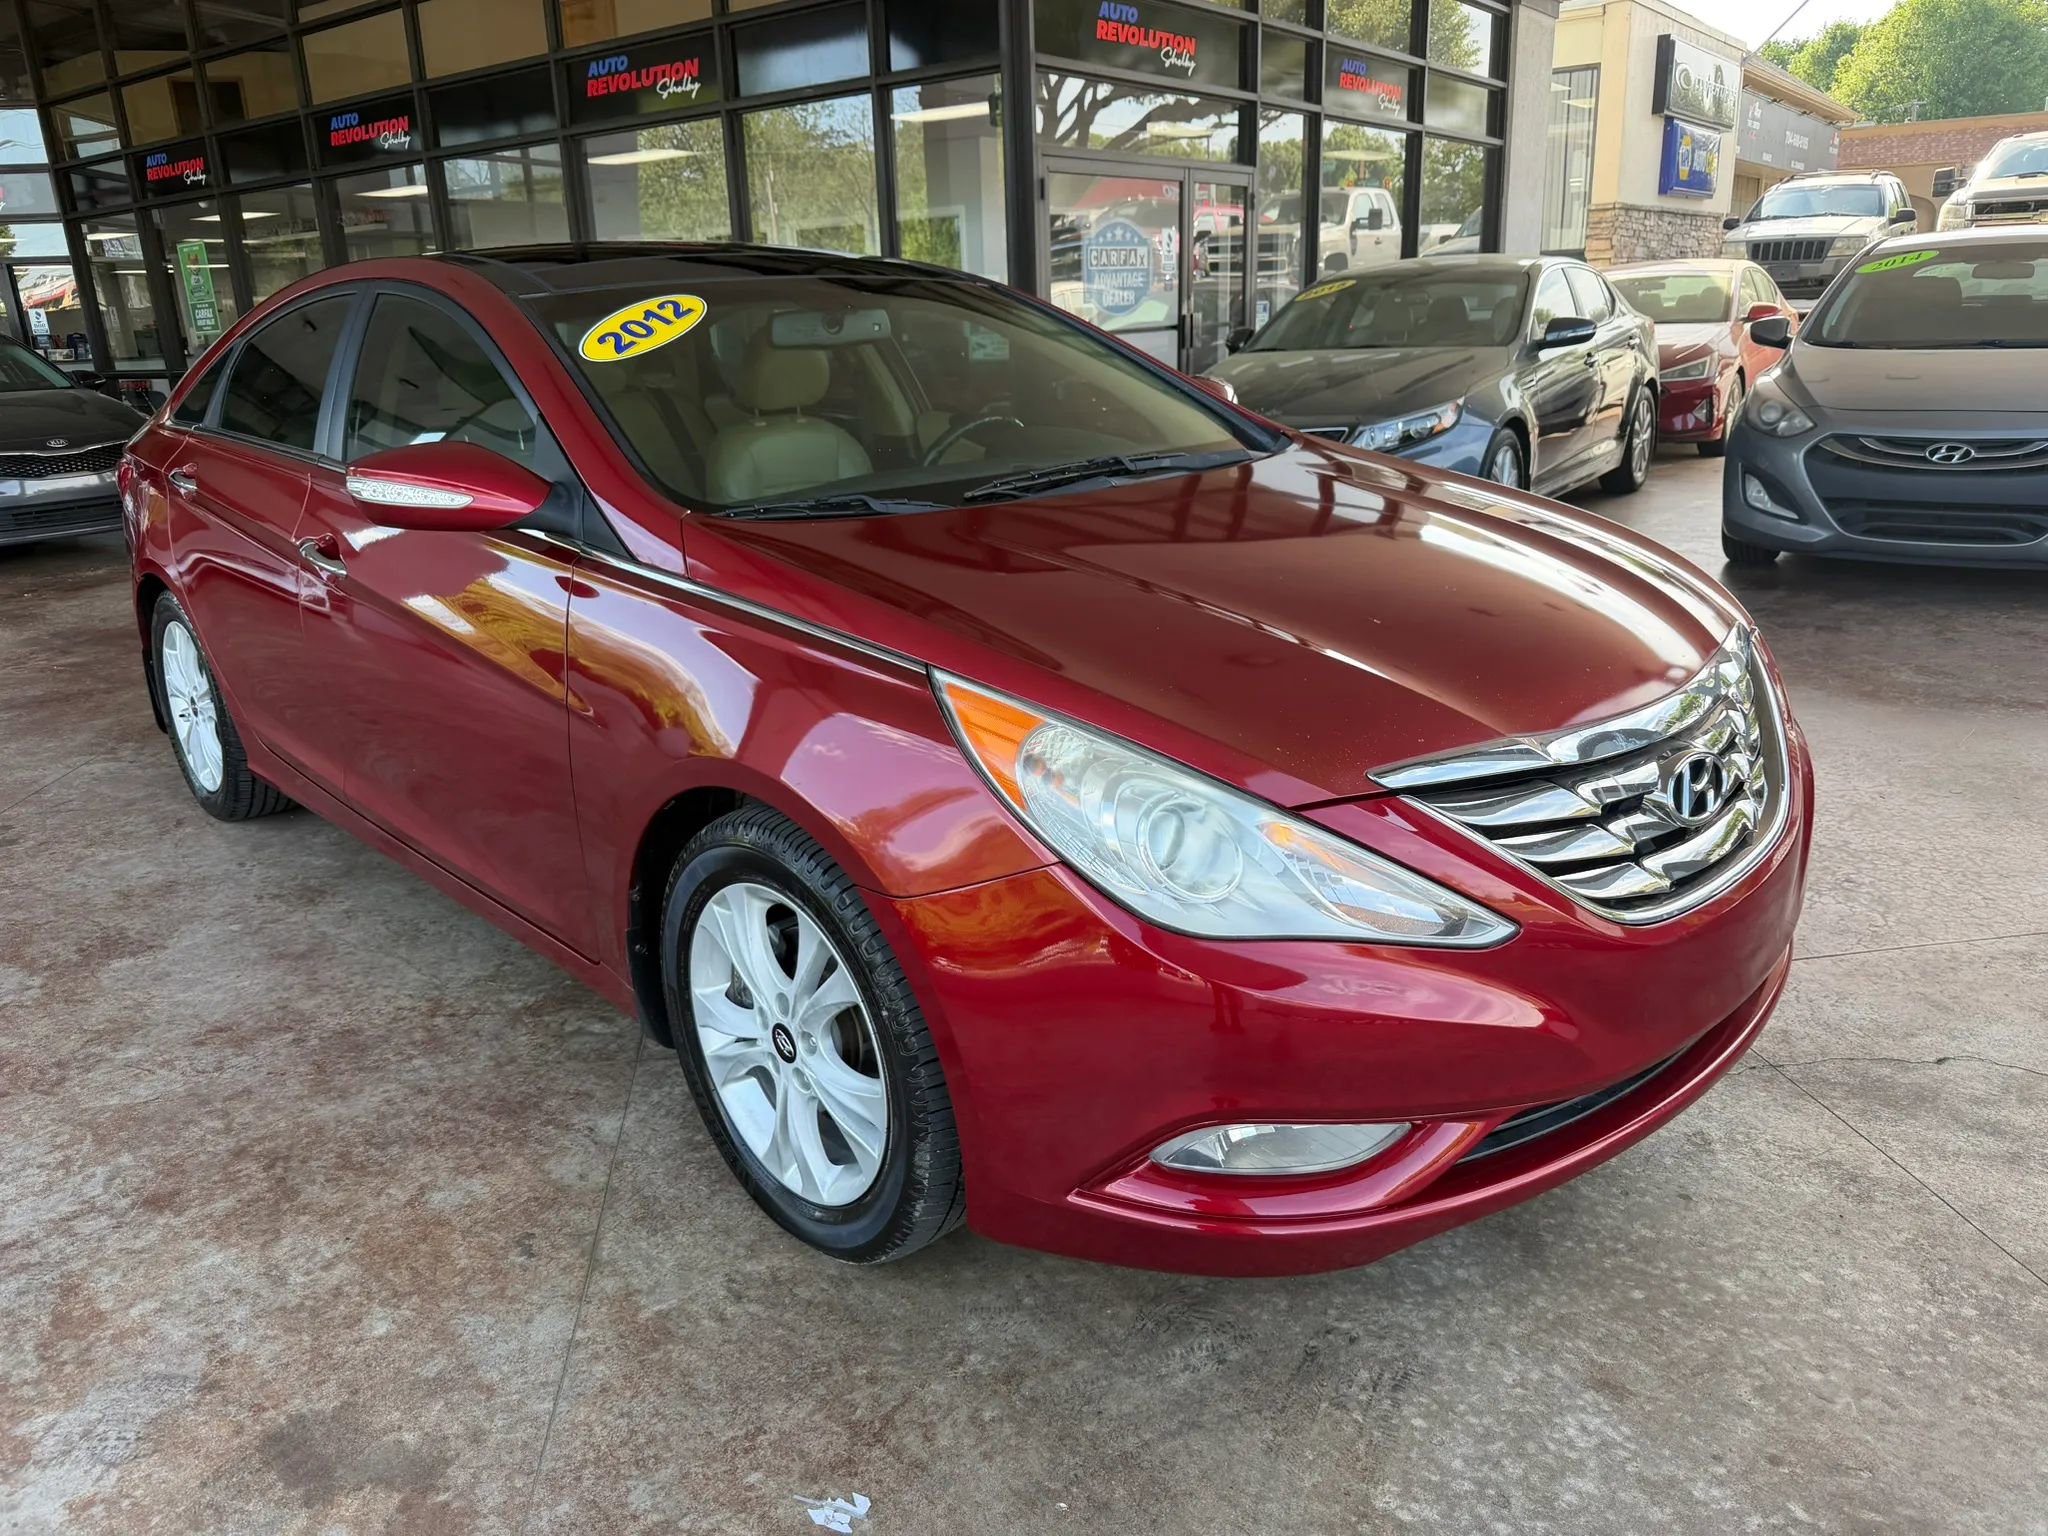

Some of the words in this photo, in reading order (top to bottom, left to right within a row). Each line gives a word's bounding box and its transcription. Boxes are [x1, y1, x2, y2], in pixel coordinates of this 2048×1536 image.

[1099, 1, 1138, 23] AUTO
[1096, 19, 1196, 56] REVOLUTION
[588, 55, 628, 77] AUTO
[1160, 46, 1196, 77] Shelby
[1341, 58, 1367, 75] AUTO
[587, 57, 699, 97] REVOLUTION
[656, 73, 701, 99] Shelby
[1339, 72, 1402, 101] REVOLUTION
[330, 112, 359, 130] AUTO
[330, 116, 409, 146] REVOLUTION
[380, 128, 411, 149] Shelby
[146, 153, 166, 167] AUTO
[147, 156, 204, 181] REVOLUTION
[1089, 248, 1147, 268] CARFAX
[1093, 271, 1146, 289] ADVANTAGE
[1102, 290, 1136, 307] DEALER
[597, 299, 695, 355] 2012
